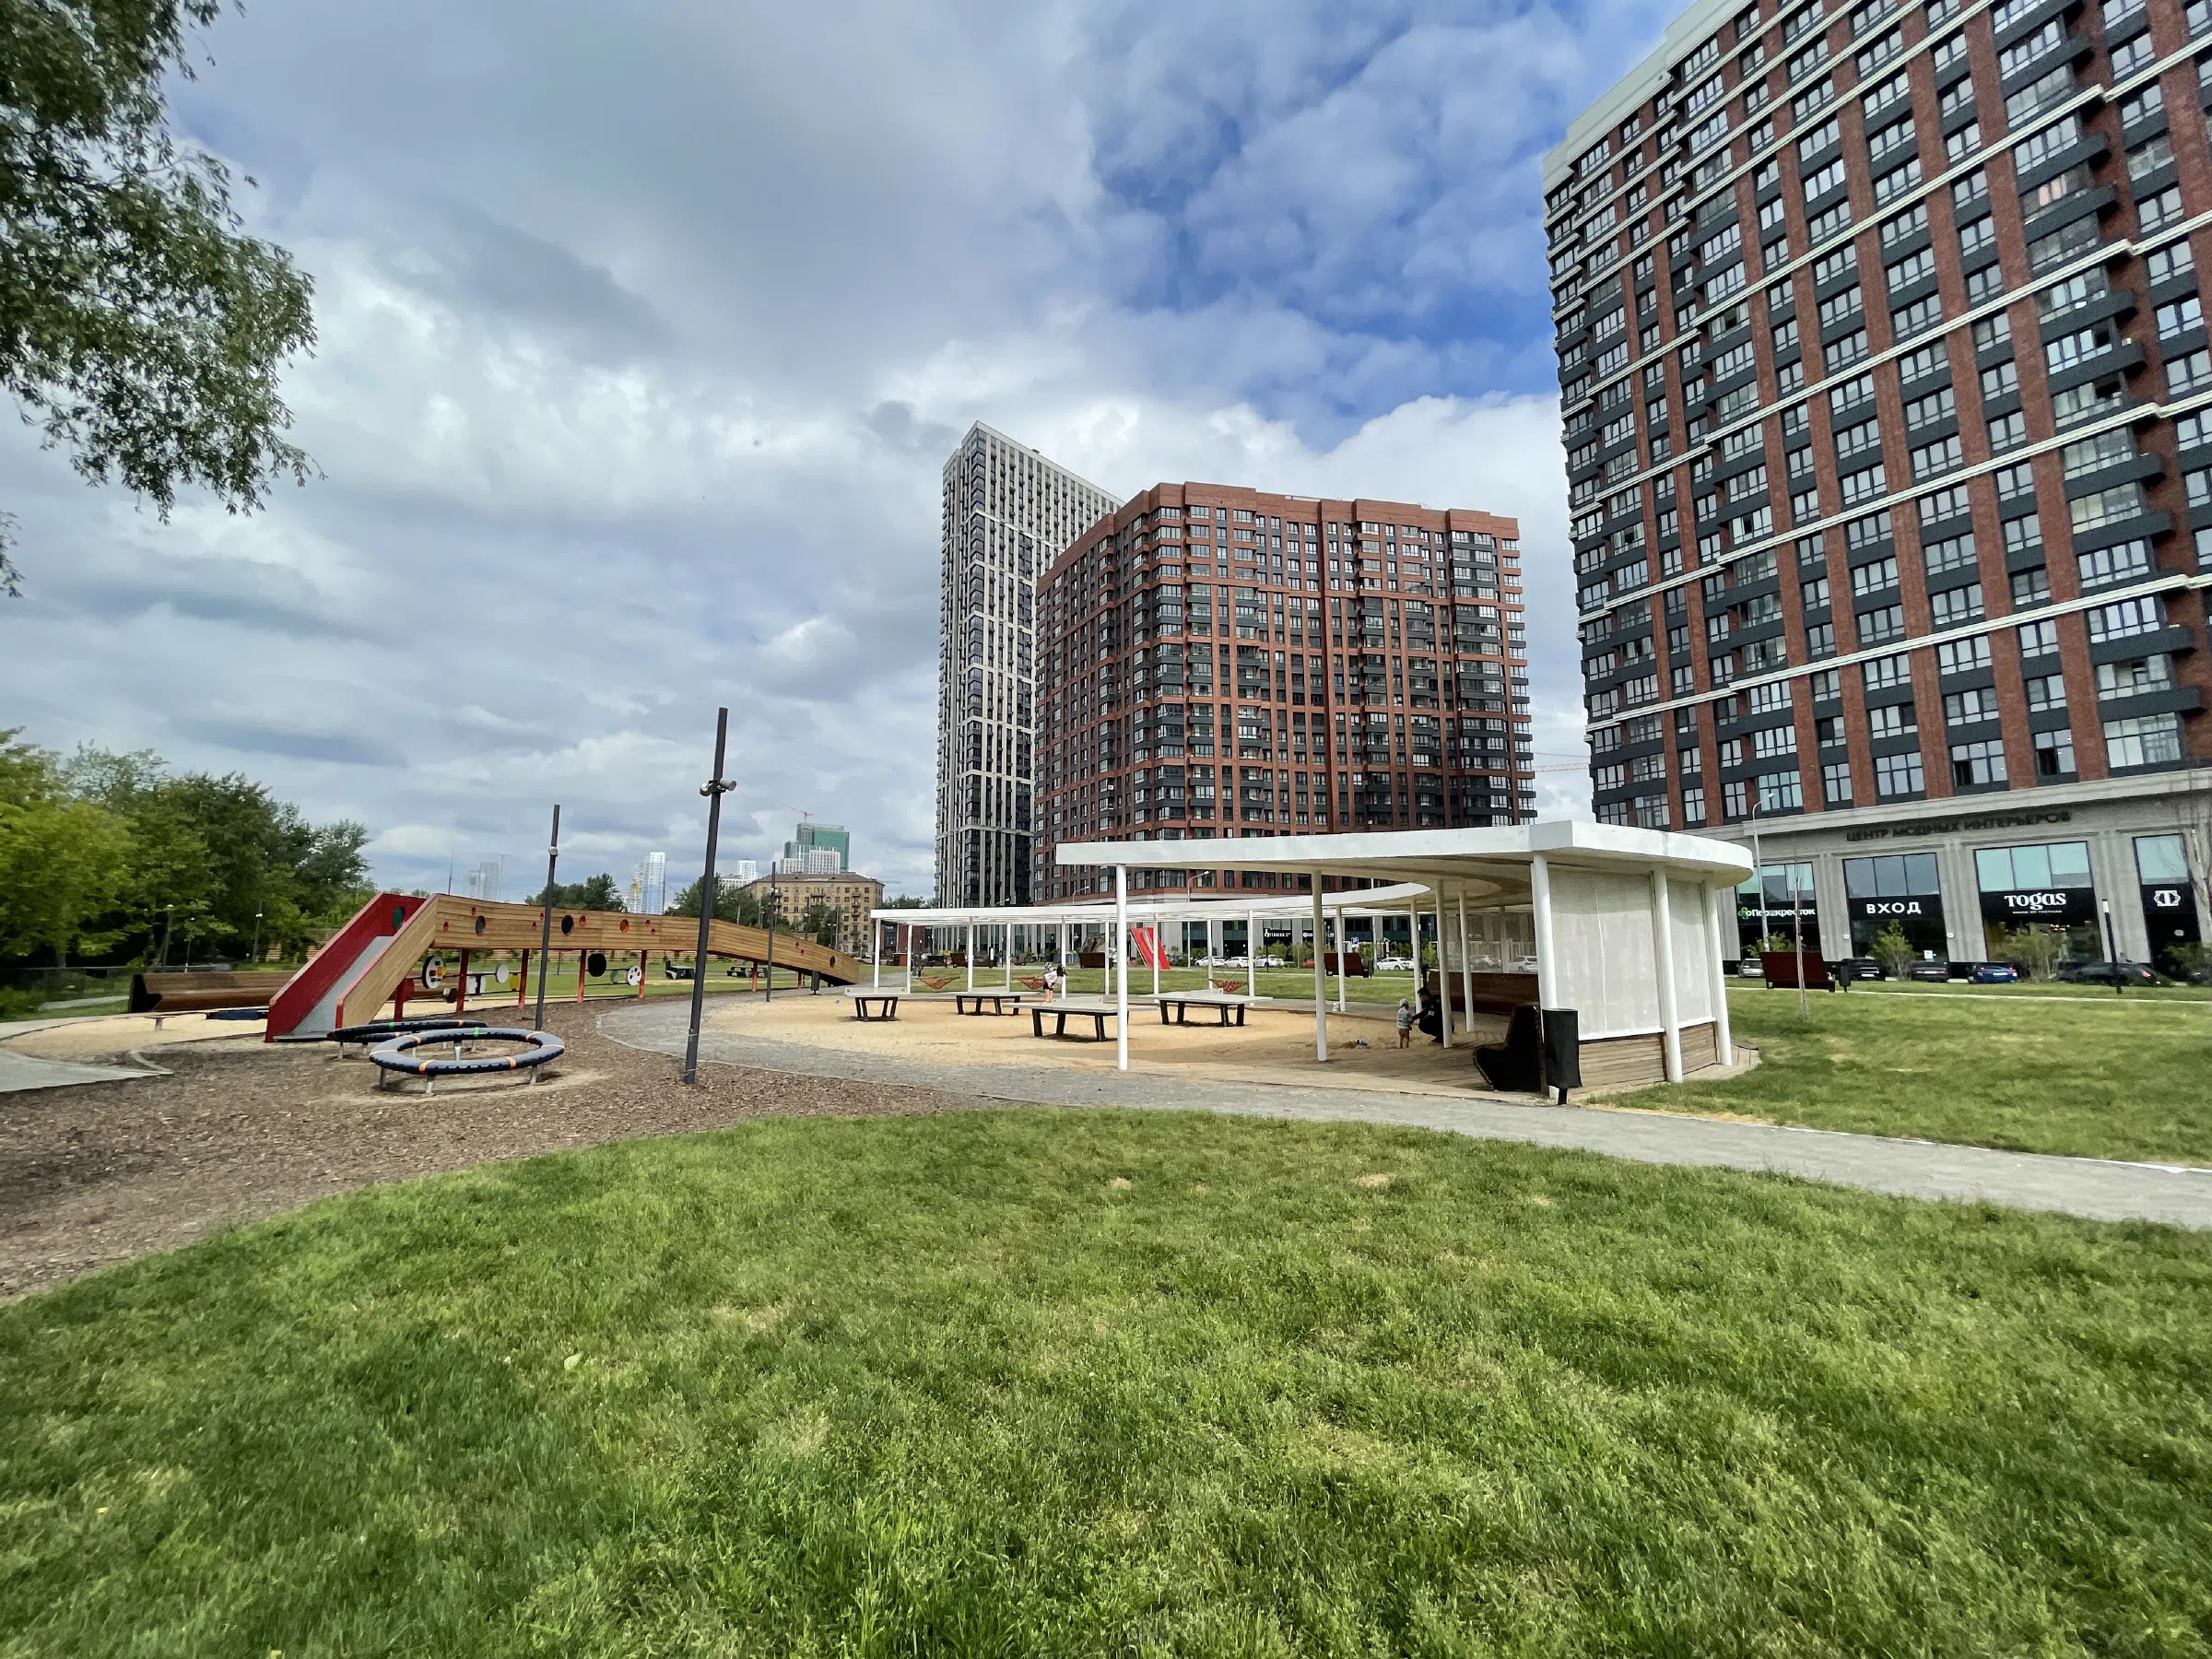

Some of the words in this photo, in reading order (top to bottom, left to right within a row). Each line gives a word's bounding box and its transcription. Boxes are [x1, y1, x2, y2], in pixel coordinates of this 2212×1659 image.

[1846, 828, 1888, 841] ЦЕНТР
[1964, 812, 2071, 830] ИНТЕРЬЕРОВ
[1866, 901, 1922, 914] ВХОД
